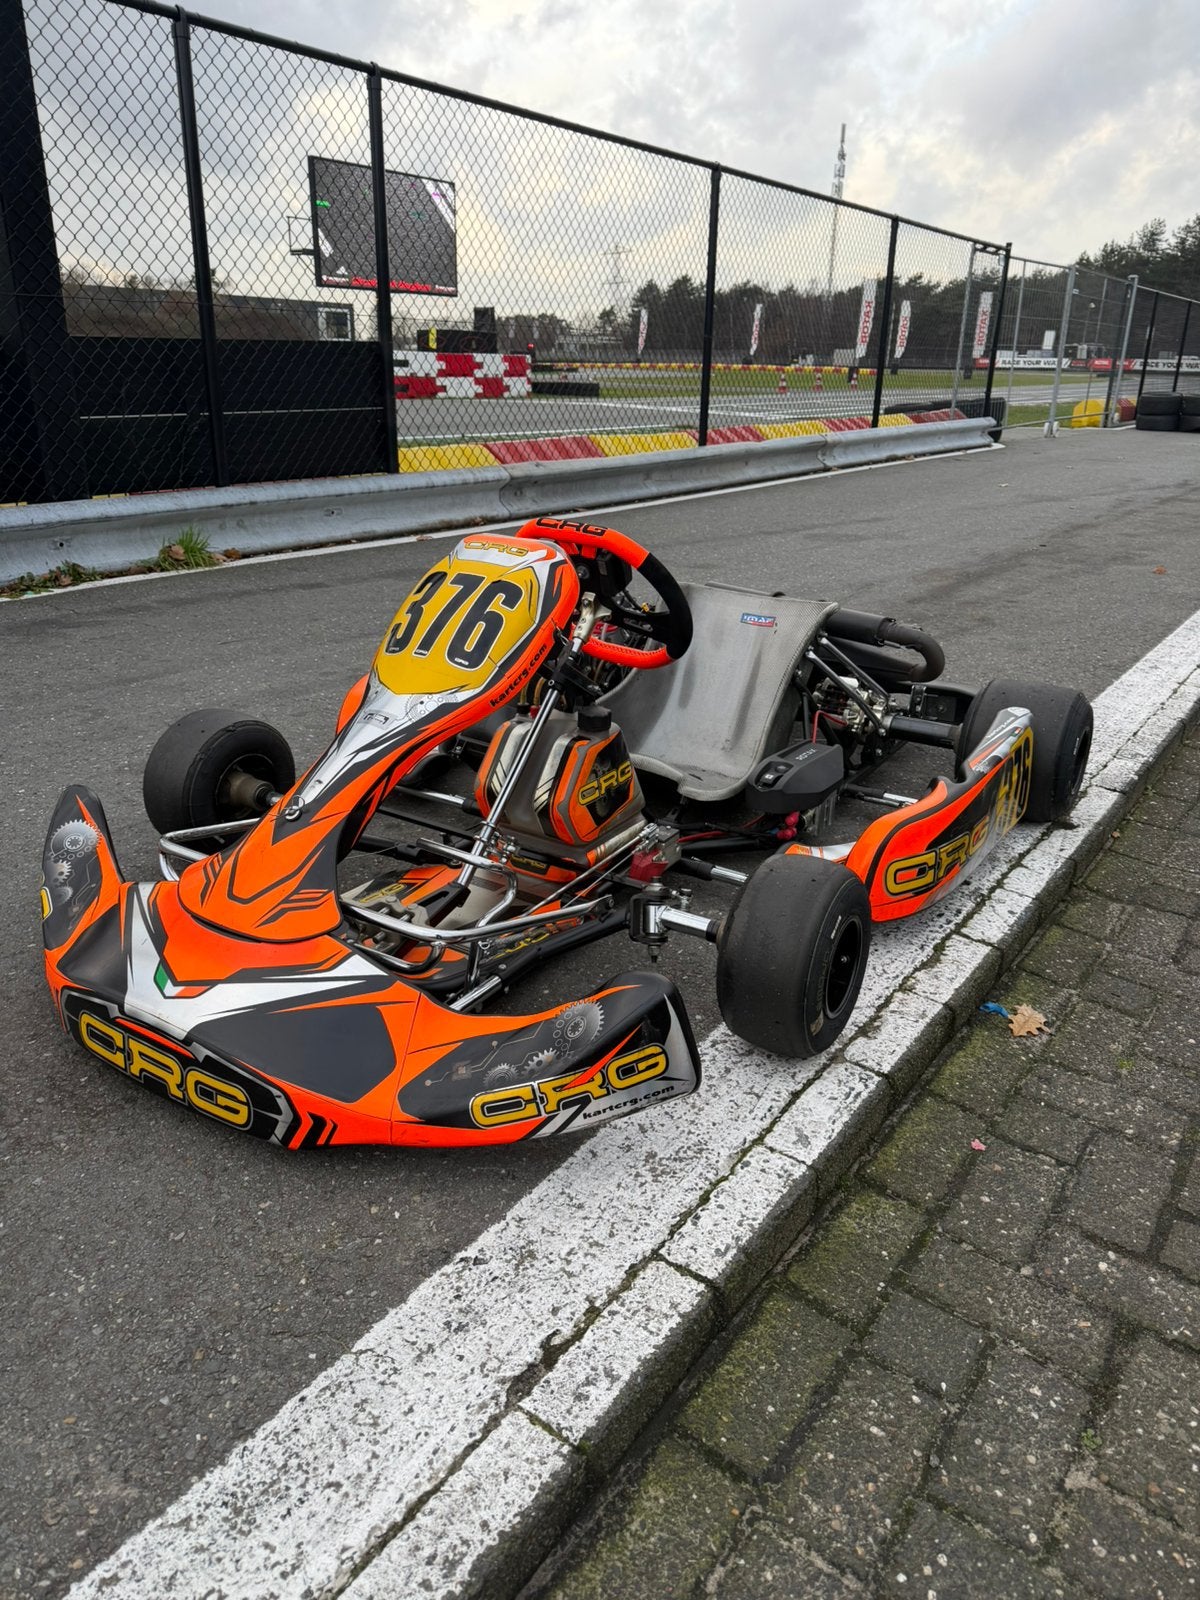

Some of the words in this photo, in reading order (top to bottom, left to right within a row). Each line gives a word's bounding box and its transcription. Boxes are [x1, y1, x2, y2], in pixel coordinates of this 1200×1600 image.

[464, 541, 529, 558] CRG
[535, 516, 608, 537] CRG
[384, 570, 525, 671] 376
[489, 642, 549, 707] kartcrg.com
[577, 760, 633, 806] CRG
[885, 814, 990, 896] CRG
[79, 1011, 252, 1130] CRG
[470, 1043, 669, 1128] CRG
[582, 1084, 676, 1120] kartcrg.com
